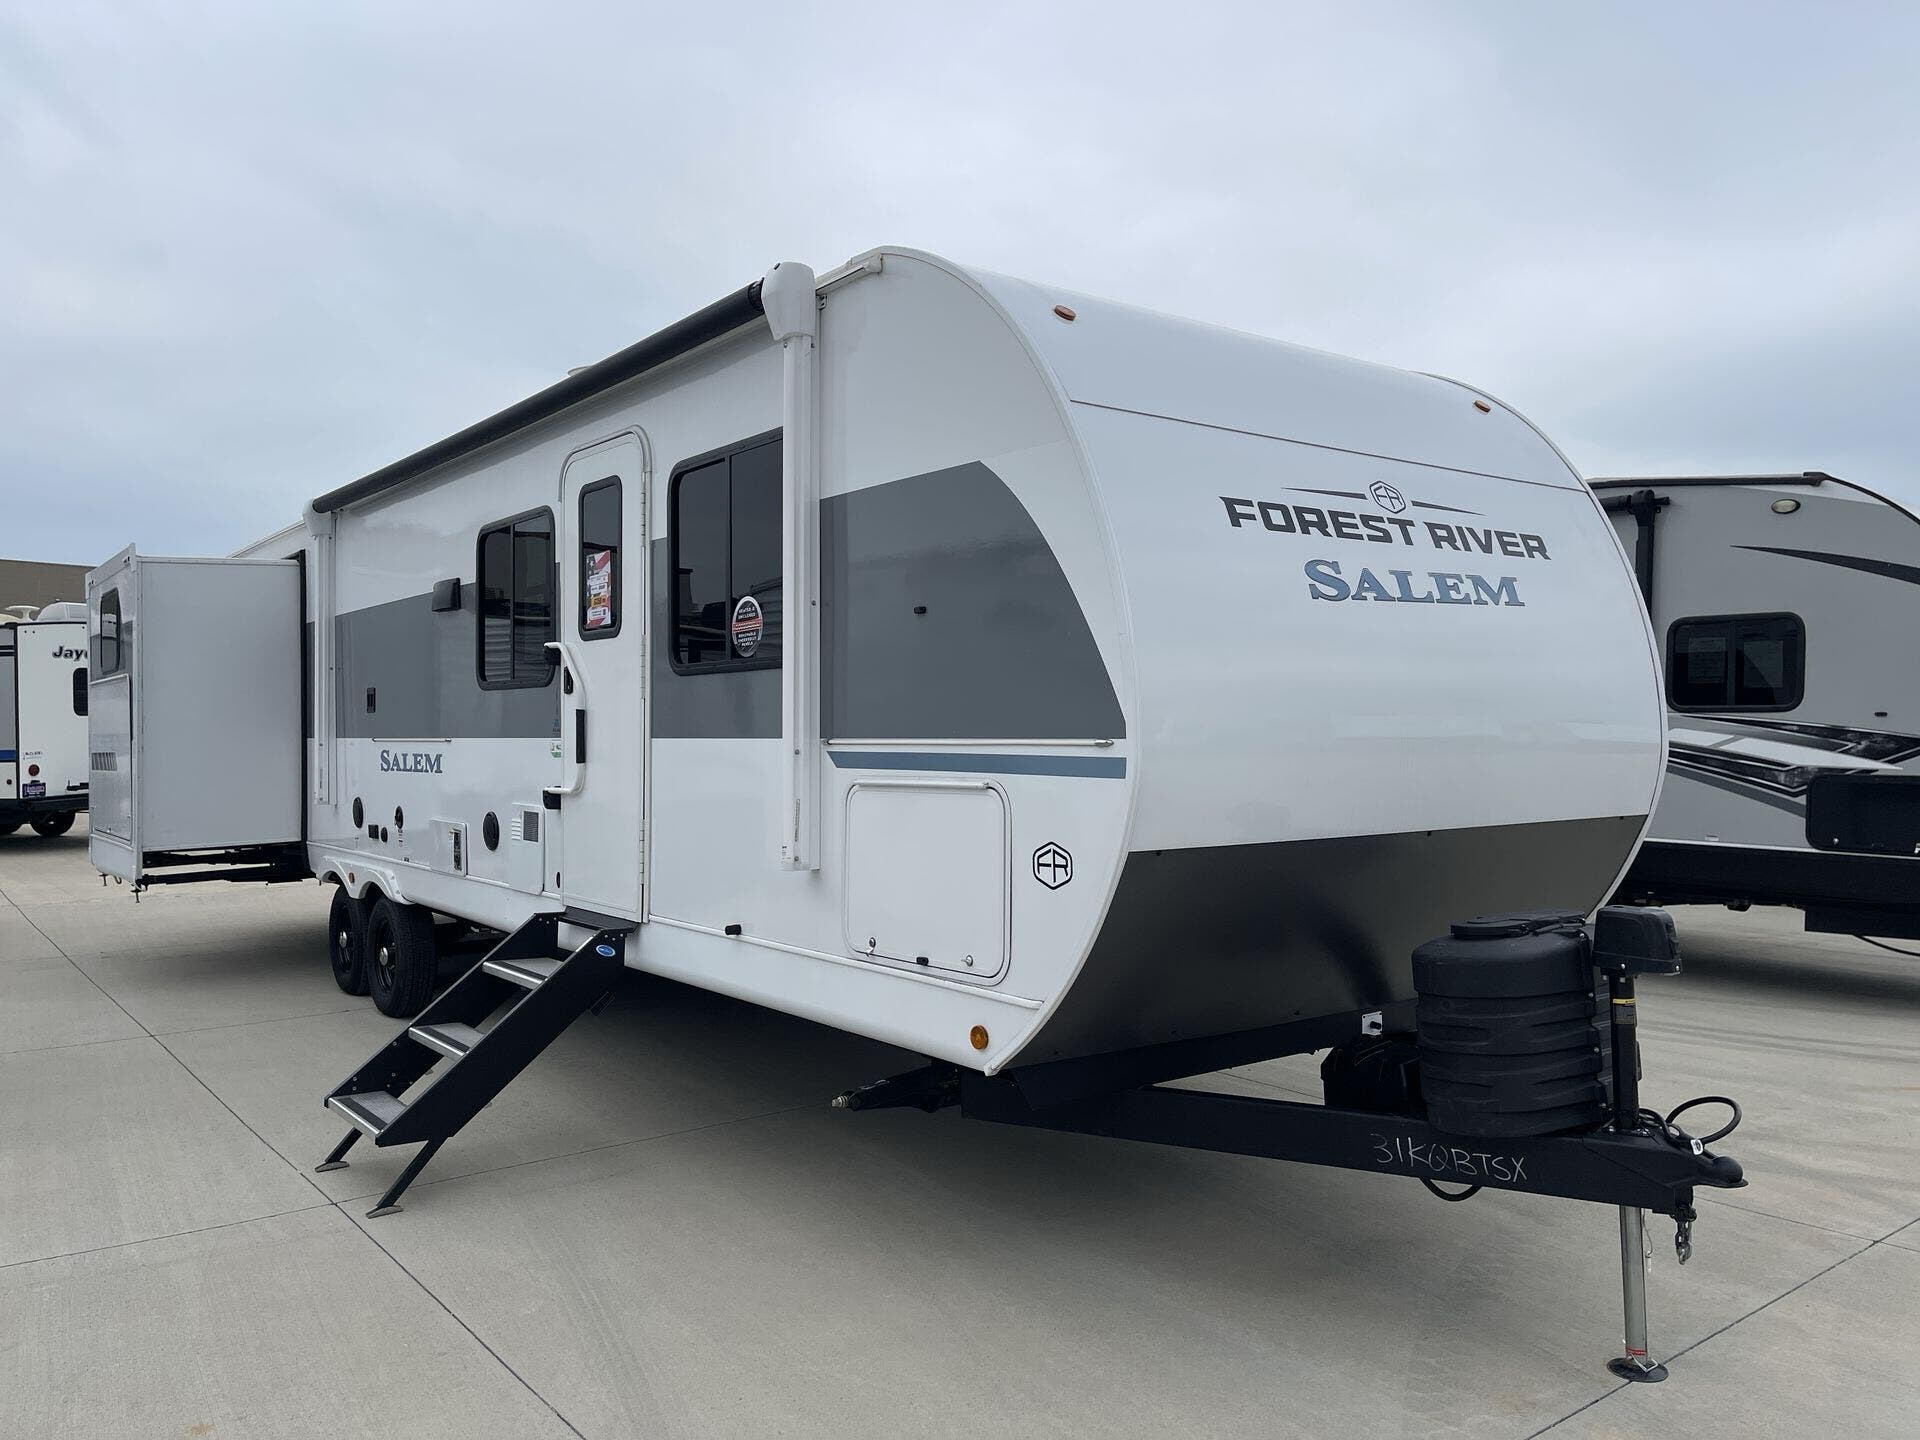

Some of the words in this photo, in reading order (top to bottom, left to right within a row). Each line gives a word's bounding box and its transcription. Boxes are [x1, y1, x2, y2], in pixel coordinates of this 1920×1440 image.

[1218, 495, 1416, 546] FOREST
[1422, 521, 1552, 561] RIVER
[1303, 558, 1526, 607] SALEM
[380, 749, 443, 773] SALEM
